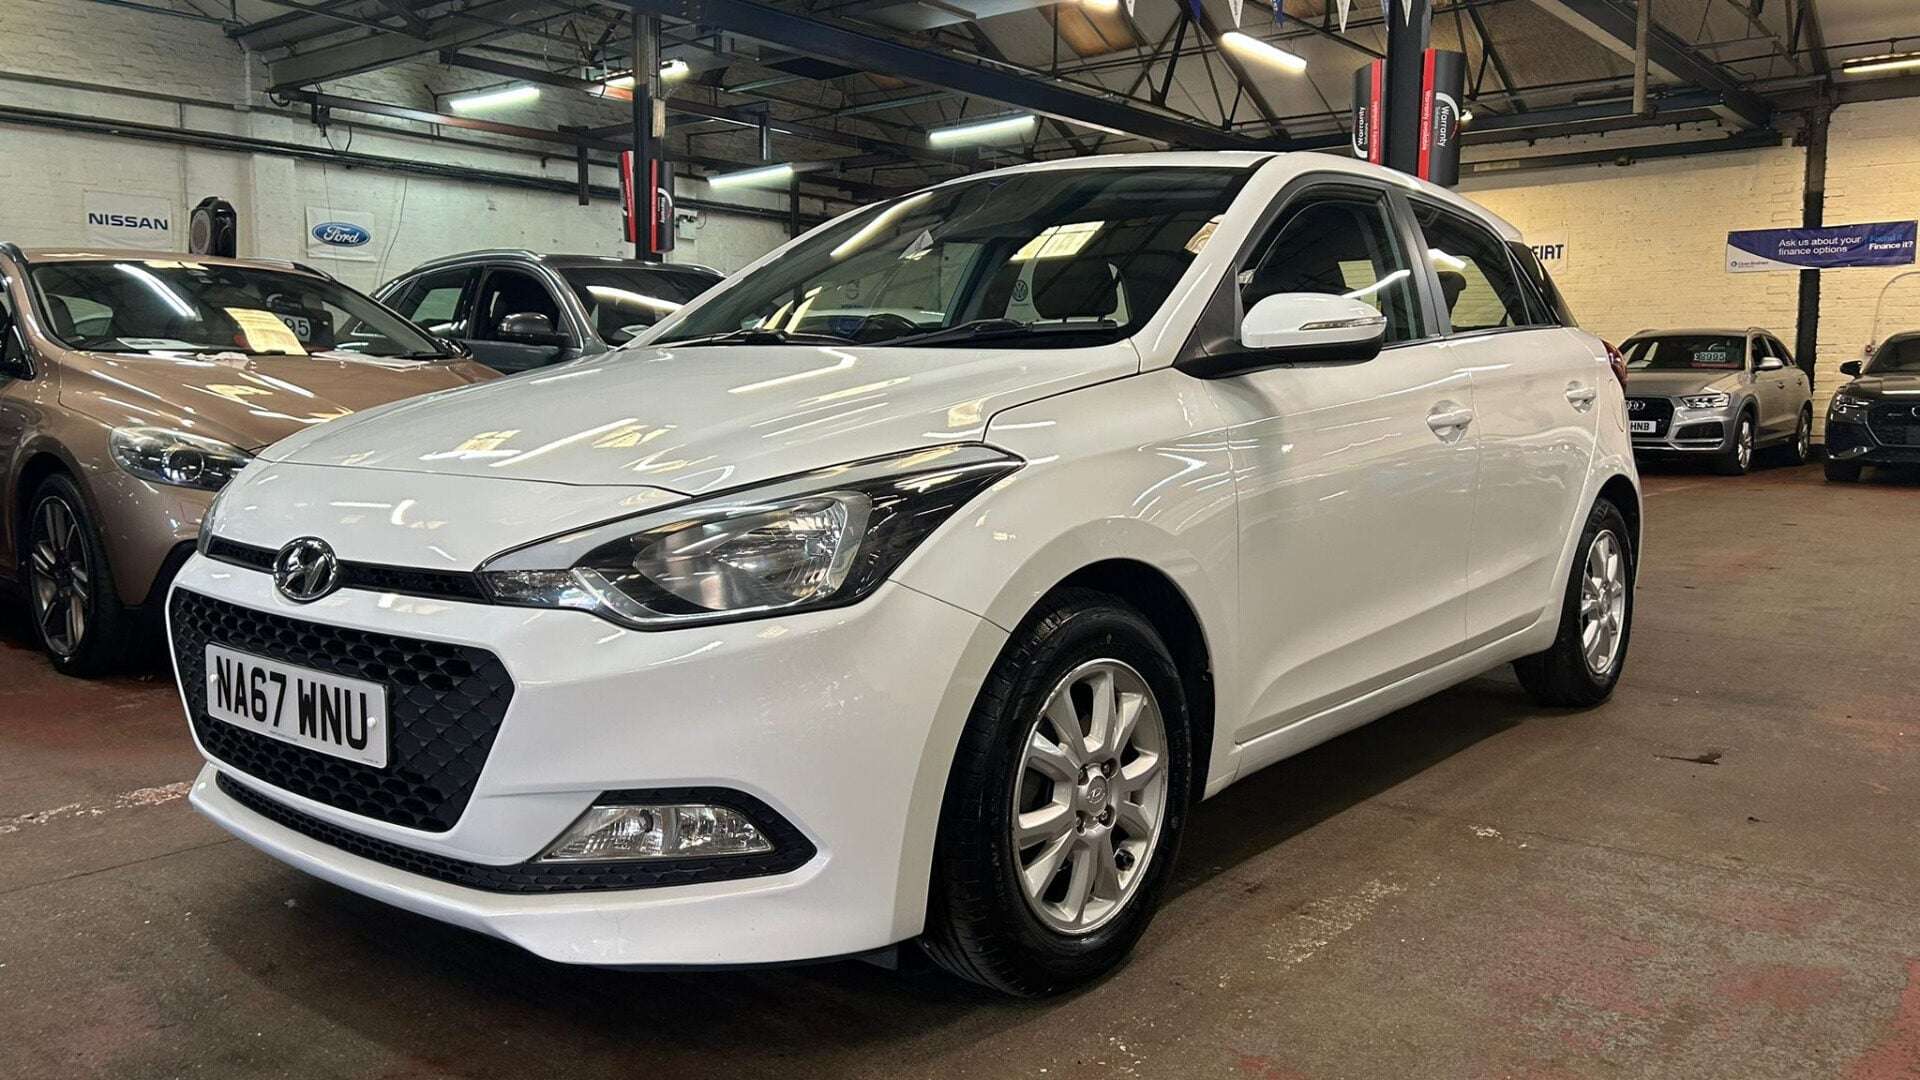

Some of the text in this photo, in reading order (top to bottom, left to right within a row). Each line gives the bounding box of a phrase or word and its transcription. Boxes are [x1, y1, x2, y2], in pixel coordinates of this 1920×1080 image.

[1357, 106, 1366, 146] Warranty
[1437, 106, 1450, 147] Warranty
[88, 213, 168, 230] NISSAN
[323, 226, 360, 242] Ford
[1778, 239, 1797, 247] Ask
[1811, 237, 1839, 246] about
[1840, 236, 1862, 246] your
[1531, 244, 1565, 260] FIAT
[1778, 246, 1848, 256] finance options
[1869, 240, 1914, 250] Finance it?
[216, 655, 368, 751] NA67 WNU
